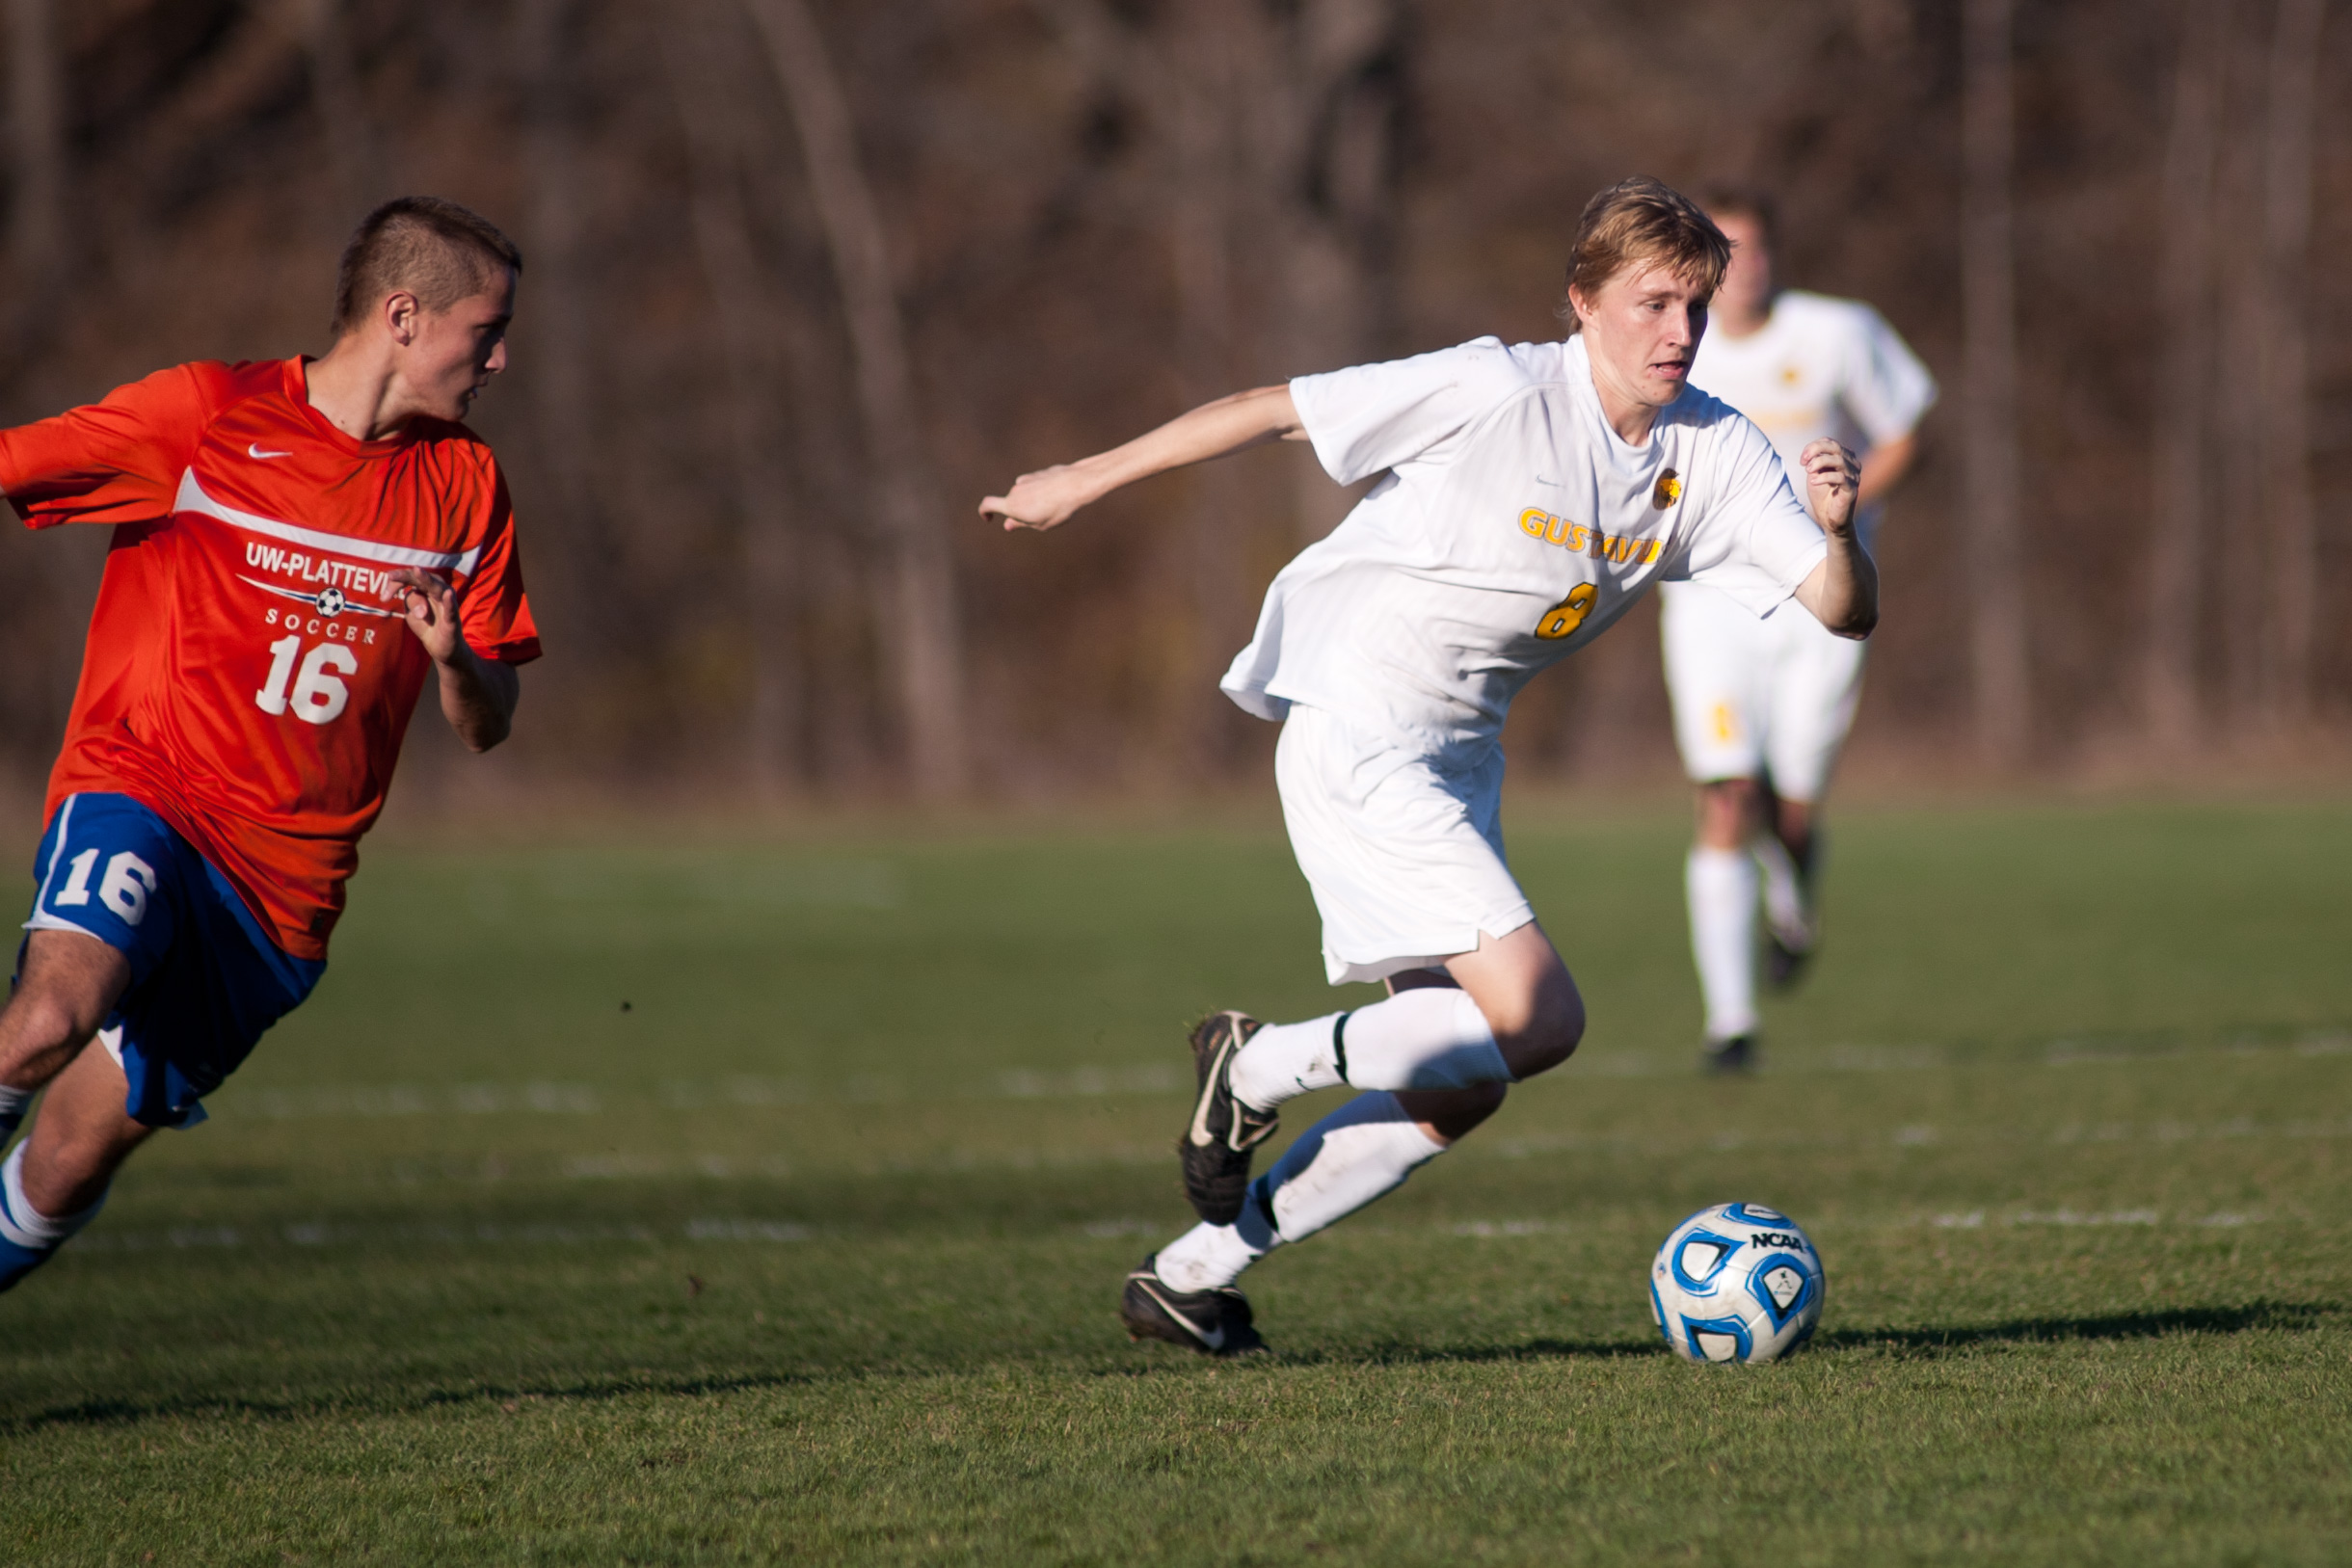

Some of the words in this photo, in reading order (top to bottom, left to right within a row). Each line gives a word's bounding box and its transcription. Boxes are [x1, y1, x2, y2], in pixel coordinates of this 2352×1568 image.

[1518, 507, 1667, 565] GUSTAVU
[265, 608, 377, 645] SOCCER
[1534, 581, 1598, 640] 8
[255, 635, 358, 724] 16
[54, 848, 157, 925] 16
[1751, 1233, 1804, 1253] NCAA
